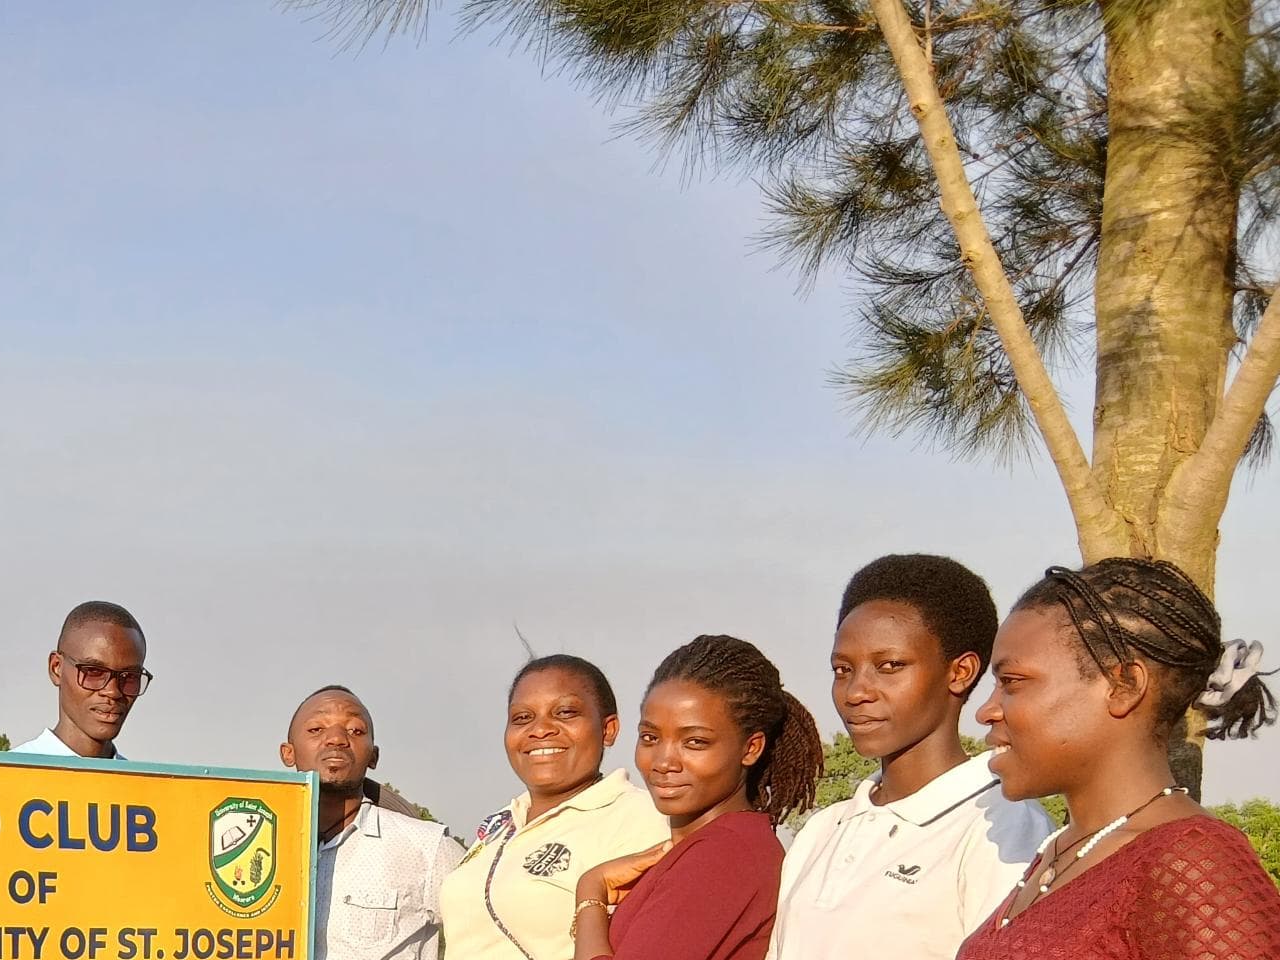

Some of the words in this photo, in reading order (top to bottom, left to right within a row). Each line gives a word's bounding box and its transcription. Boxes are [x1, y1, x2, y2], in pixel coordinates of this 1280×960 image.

[18, 798, 158, 852] CLUB
[8, 870, 58, 904] OF
[59, 926, 108, 960] OF
[117, 926, 166, 960] ST.
[173, 928, 295, 960] JOSEPH
